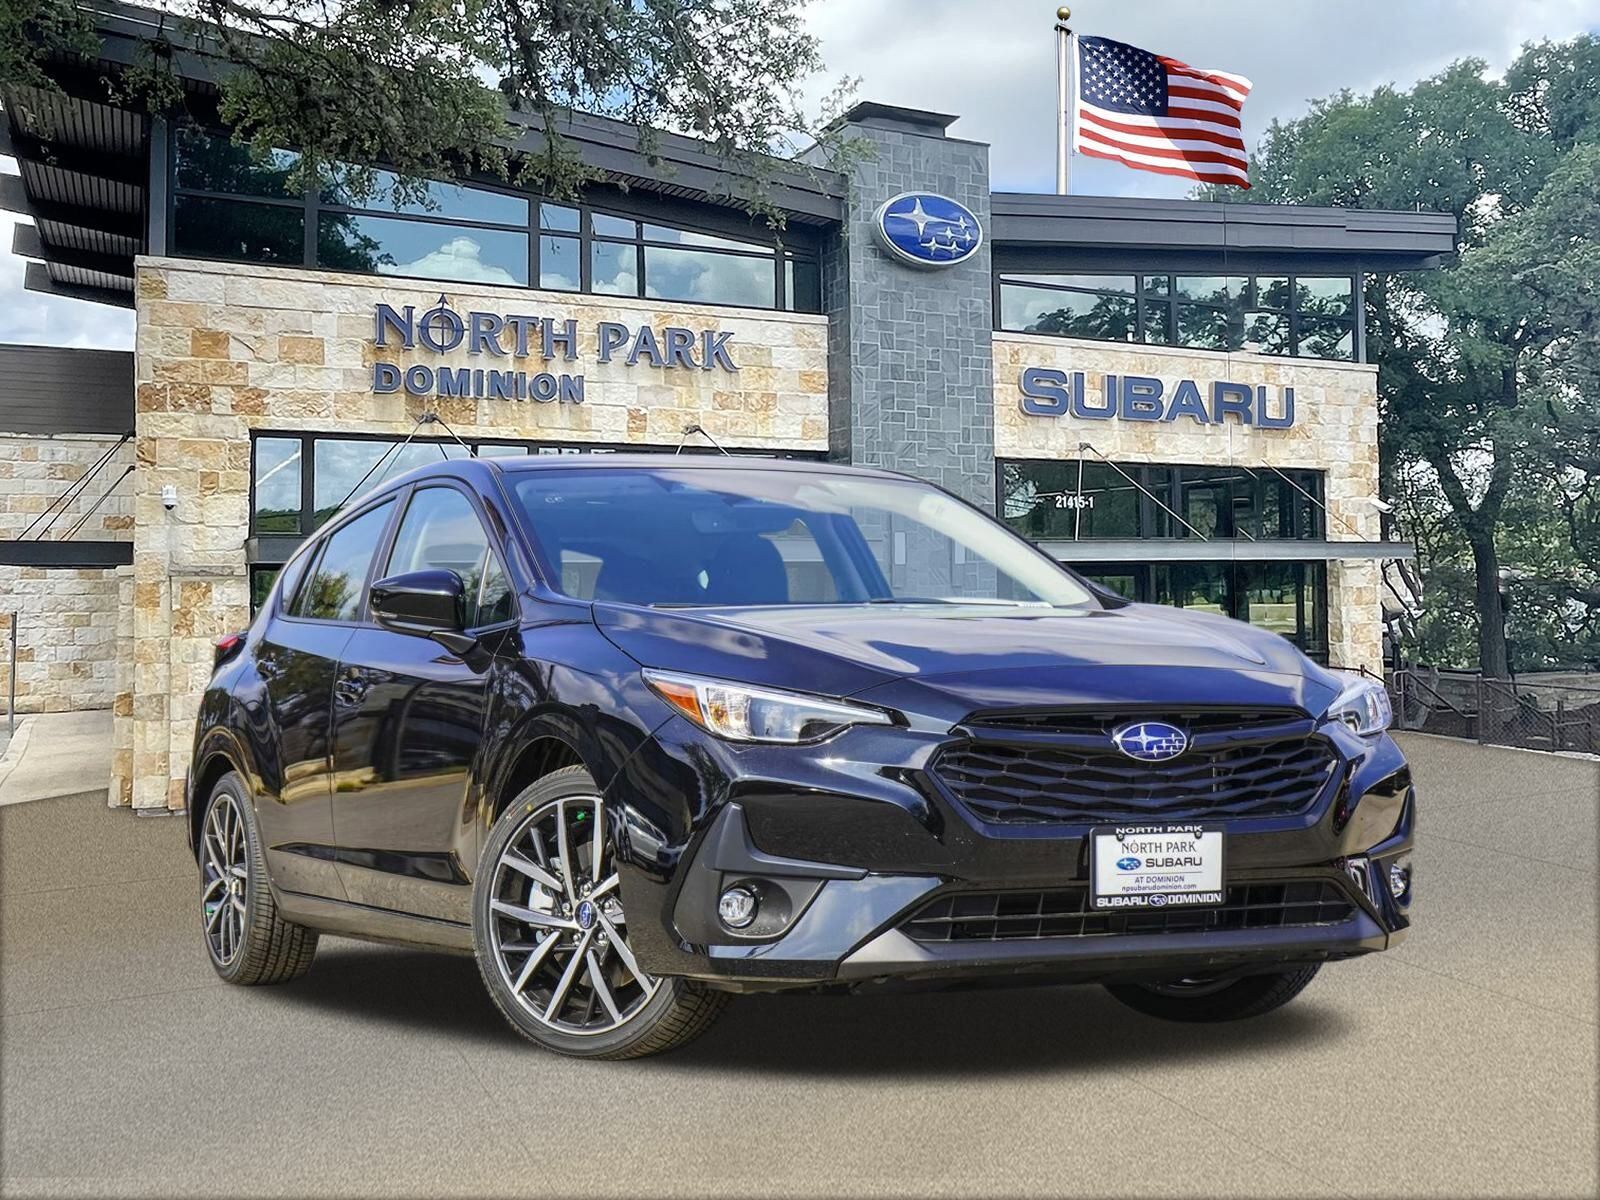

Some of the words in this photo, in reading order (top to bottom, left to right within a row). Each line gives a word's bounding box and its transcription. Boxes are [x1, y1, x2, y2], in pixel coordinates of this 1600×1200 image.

[374, 295, 579, 361] NORTH
[597, 321, 741, 373] PARK
[373, 362, 585, 404] DOMINION
[1018, 366, 1295, 430] SUBARU
[1115, 826, 1163, 835] NORTH
[1167, 824, 1203, 833] PARK
[1121, 840, 1162, 855] NORTH
[1166, 841, 1197, 854] PARK
[1145, 857, 1202, 868] SUBARU
[1134, 876, 1143, 884] AT
[1146, 875, 1185, 884] DOMINION
[1121, 883, 1197, 892] npsubarudominion.com
[1096, 896, 1148, 908] SUBARU
[1167, 892, 1222, 905] DOMINION
